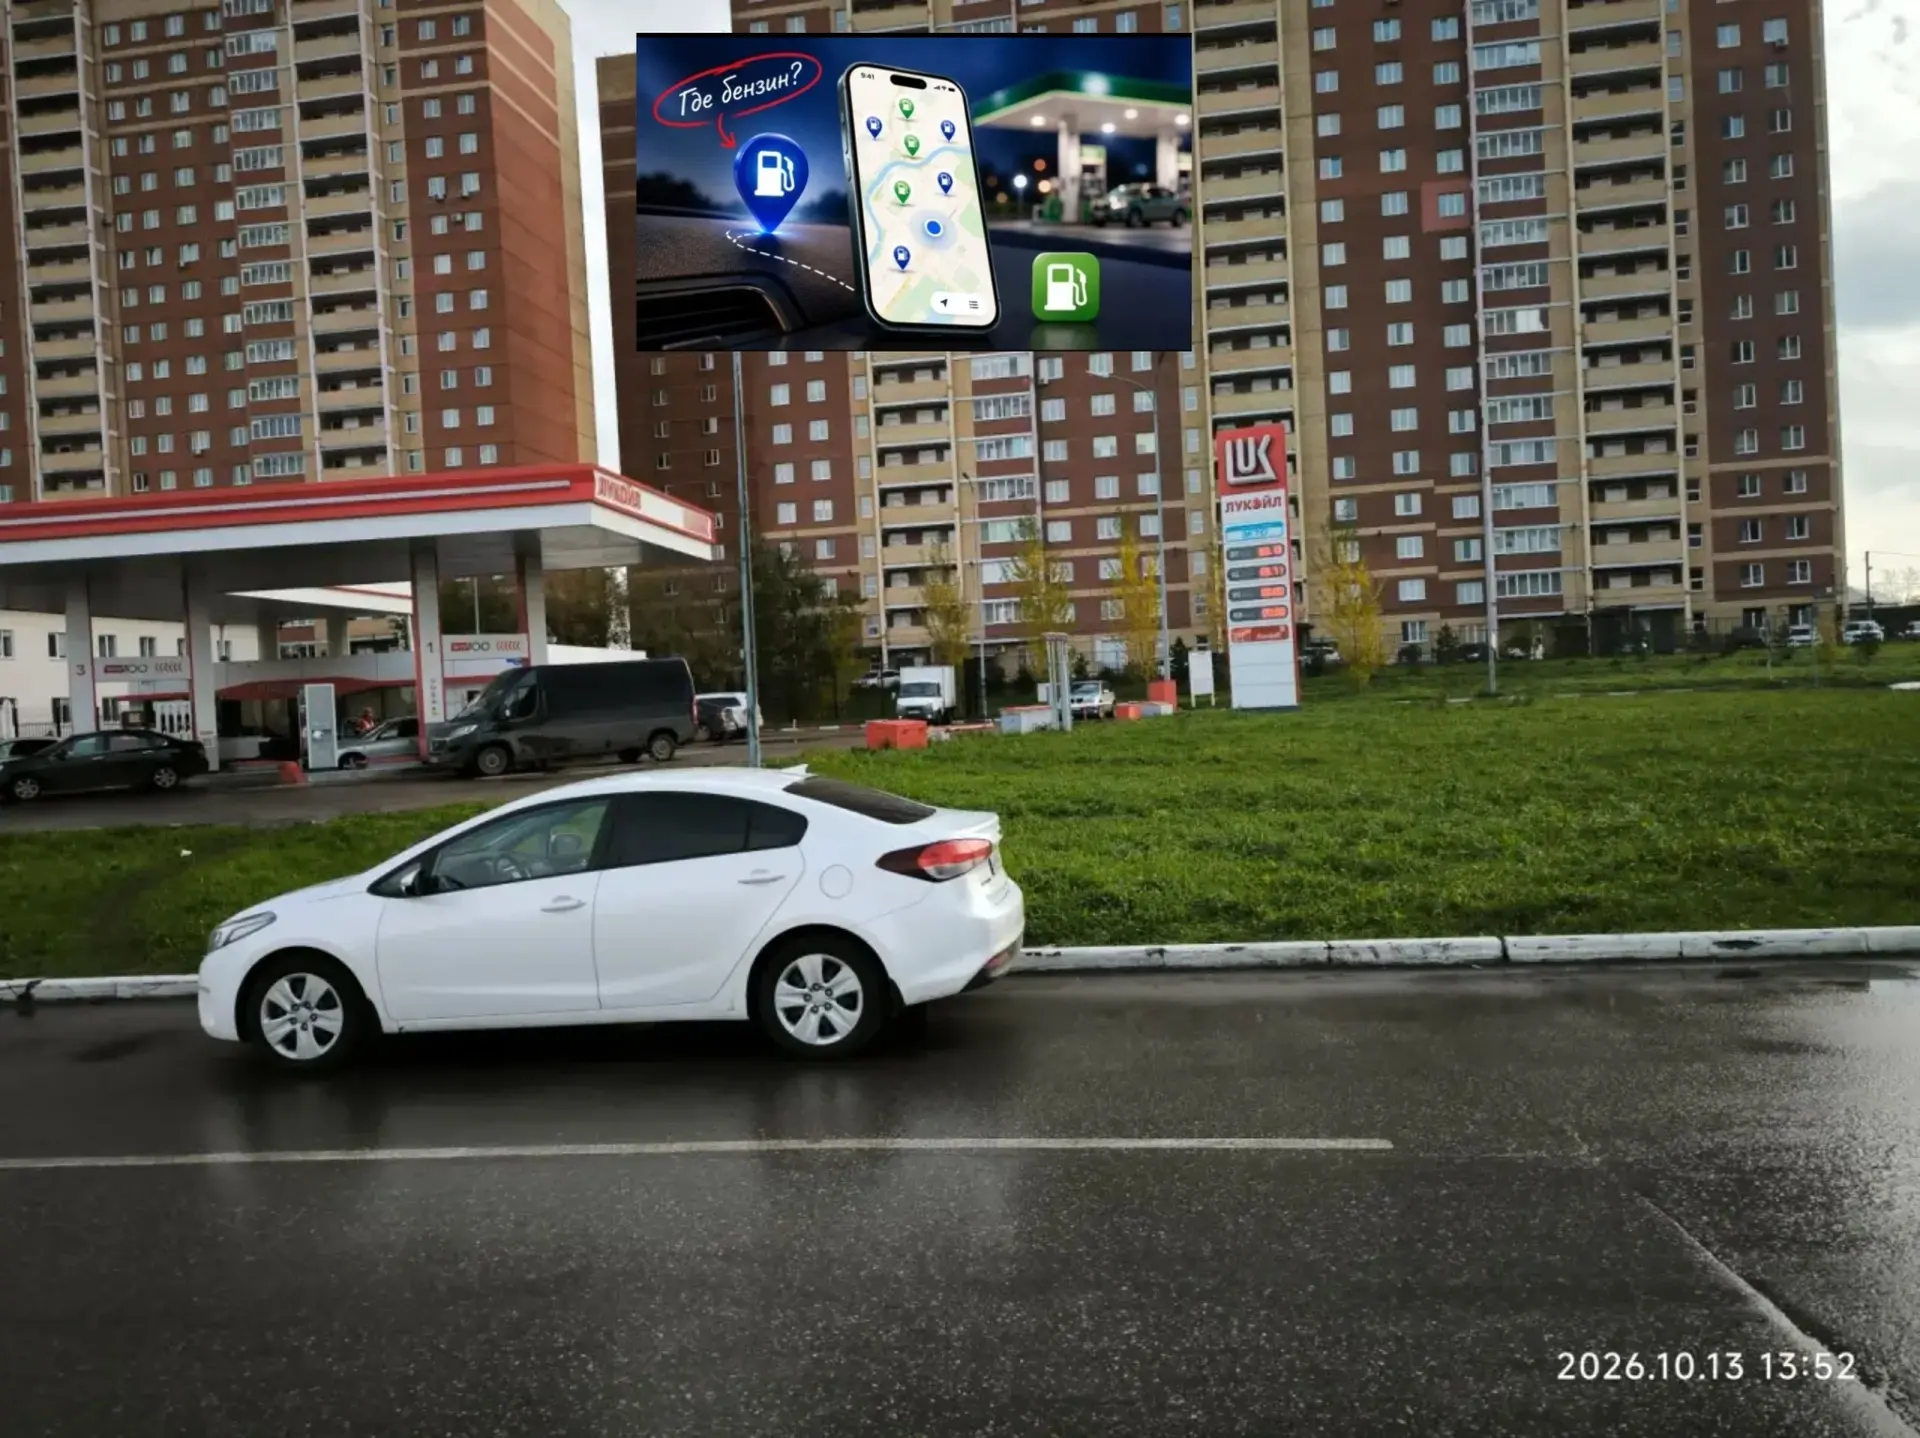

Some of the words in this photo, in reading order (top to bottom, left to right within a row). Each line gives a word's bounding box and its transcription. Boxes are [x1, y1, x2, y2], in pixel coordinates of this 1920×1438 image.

[1225, 495, 1282, 513] ЛУКОЙЛ
[426, 641, 434, 653] 1
[76, 664, 86, 676] 3
